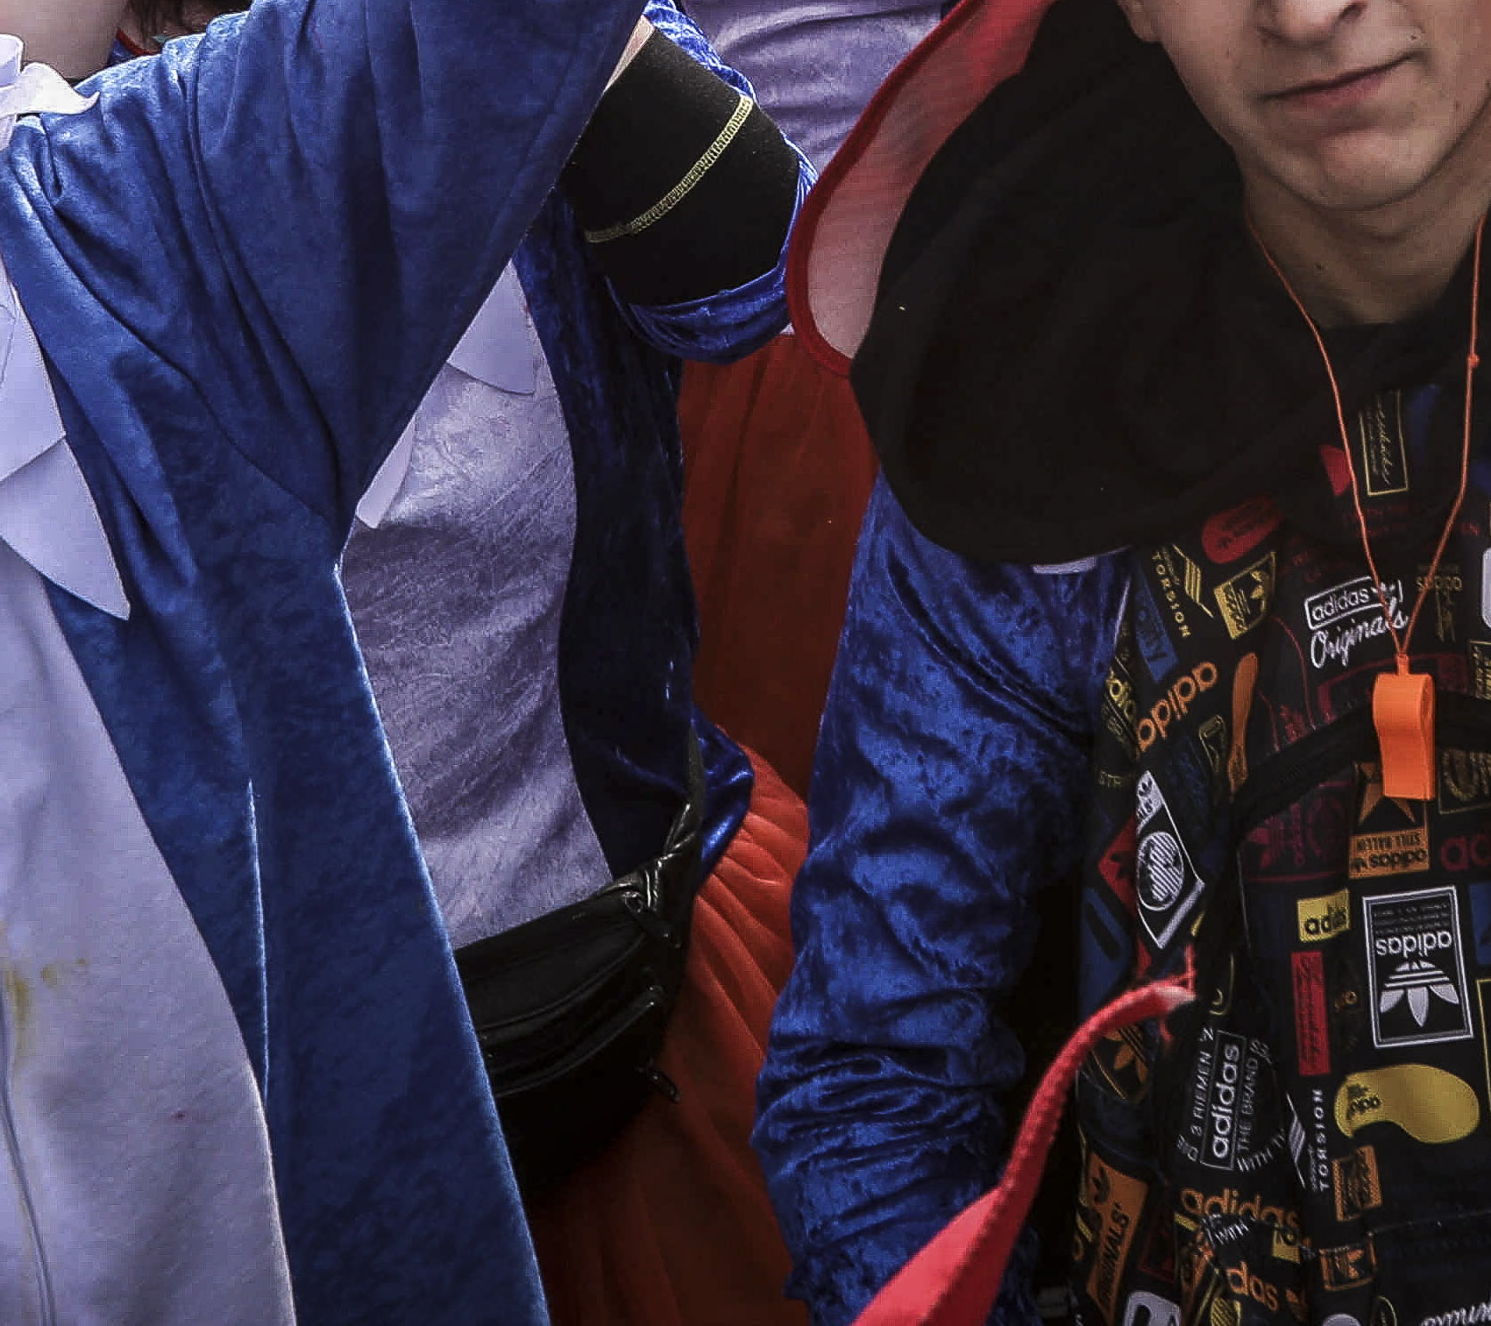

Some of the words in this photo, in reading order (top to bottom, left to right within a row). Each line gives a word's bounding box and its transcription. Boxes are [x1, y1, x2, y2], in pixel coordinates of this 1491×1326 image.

[1151, 551, 1192, 638] TORSION
[1311, 587, 1370, 623] adidas
[1370, 848, 1427, 868] adidas
[1375, 929, 1453, 960] adidas
[1211, 1043, 1240, 1160] adidas
[1312, 1088, 1330, 1193] TORSION
